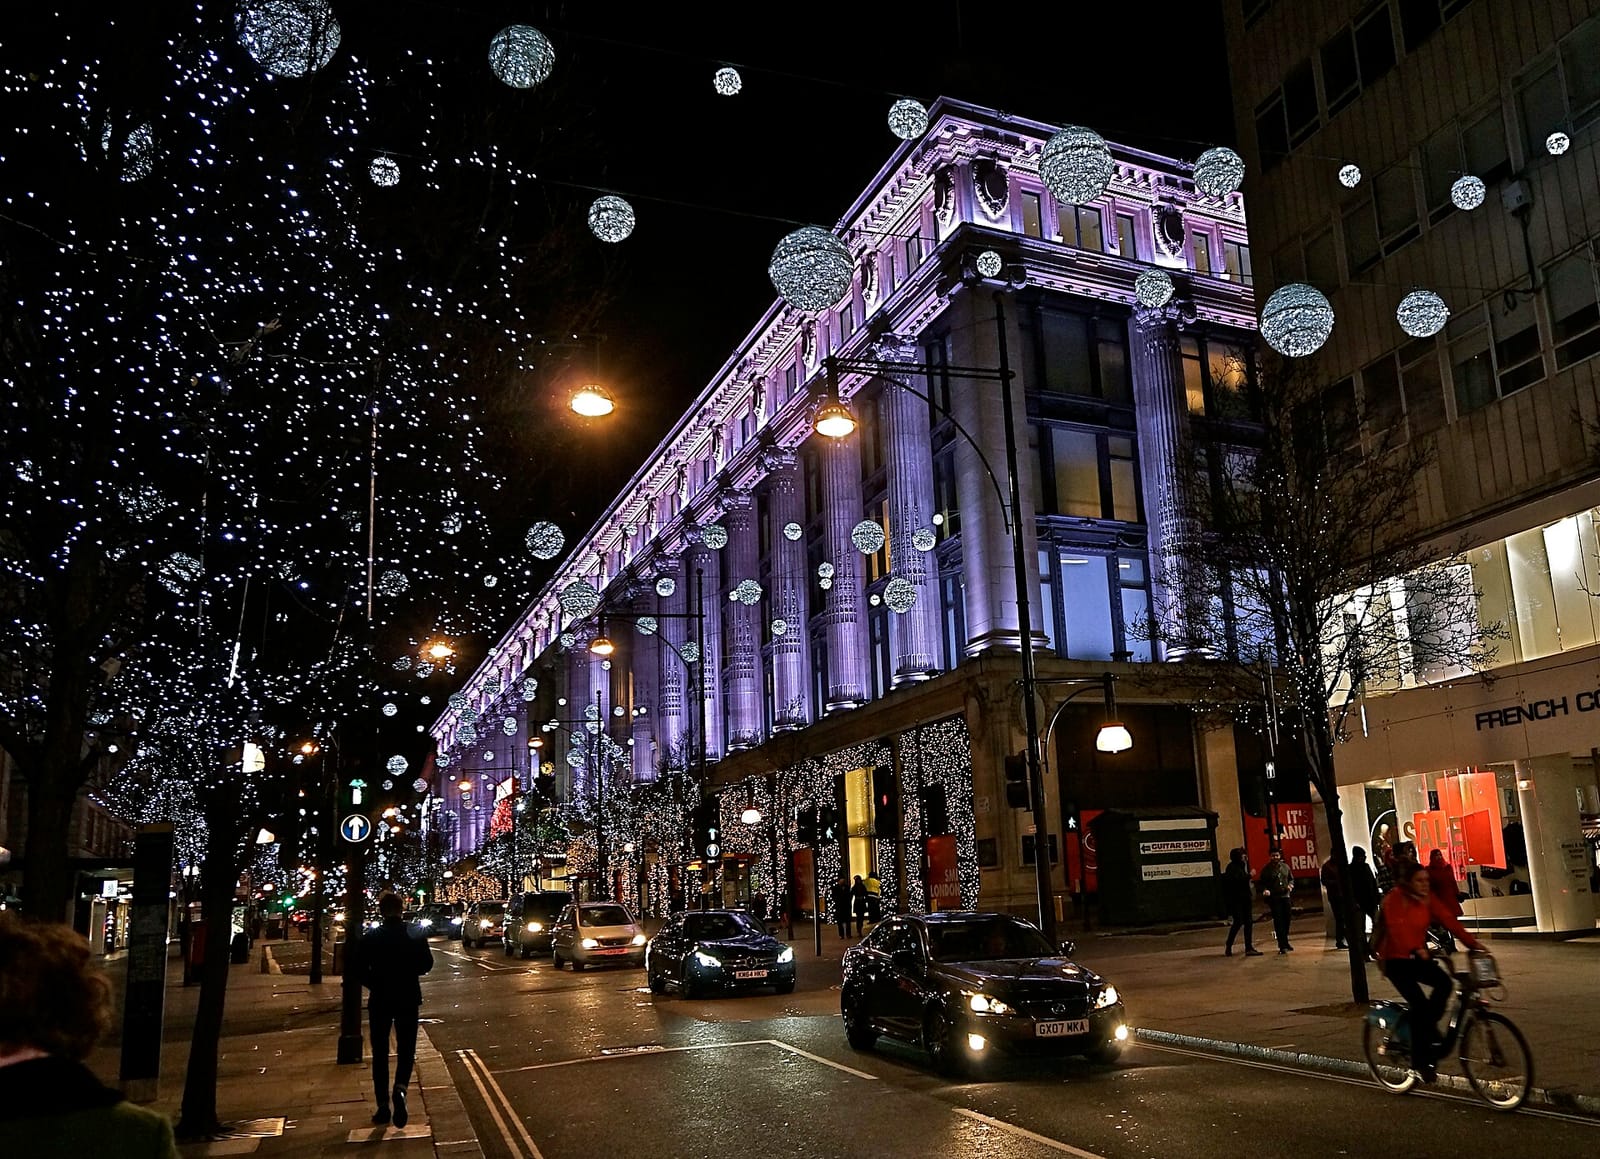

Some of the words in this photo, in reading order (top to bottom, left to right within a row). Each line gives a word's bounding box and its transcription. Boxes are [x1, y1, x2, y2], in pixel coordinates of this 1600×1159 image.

[1475, 696, 1569, 731] FRENCH
[1403, 817, 1464, 849] SALE
[1151, 842, 1182, 850] GUITAR
[1306, 839, 1315, 854] B
[1290, 854, 1319, 870] REM
[930, 883, 960, 897] LONDON
[1039, 1023, 1065, 1035] GX07
